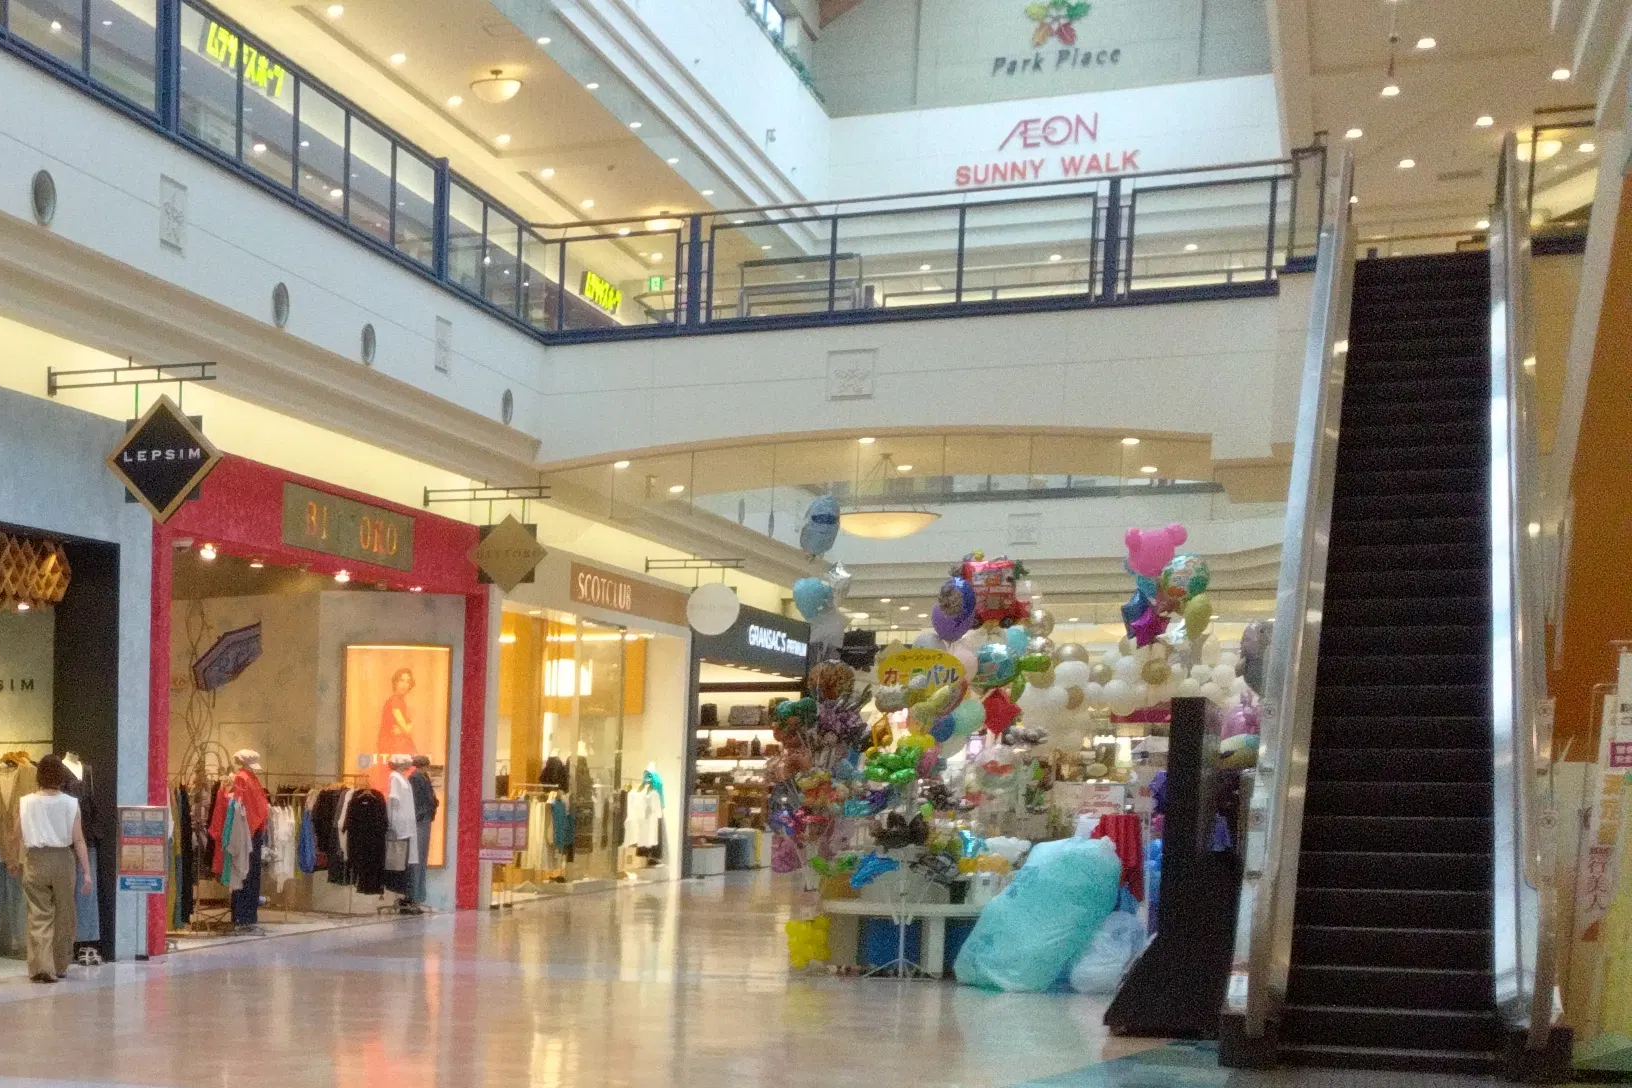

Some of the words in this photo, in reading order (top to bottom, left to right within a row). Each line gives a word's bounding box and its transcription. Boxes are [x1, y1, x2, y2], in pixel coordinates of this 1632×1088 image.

[990, 53, 1044, 77] Park
[1055, 48, 1121, 71] Place
[955, 158, 1046, 187] SUNNY
[1060, 149, 1141, 178] WALK
[123, 448, 201, 463] LEPSIM
